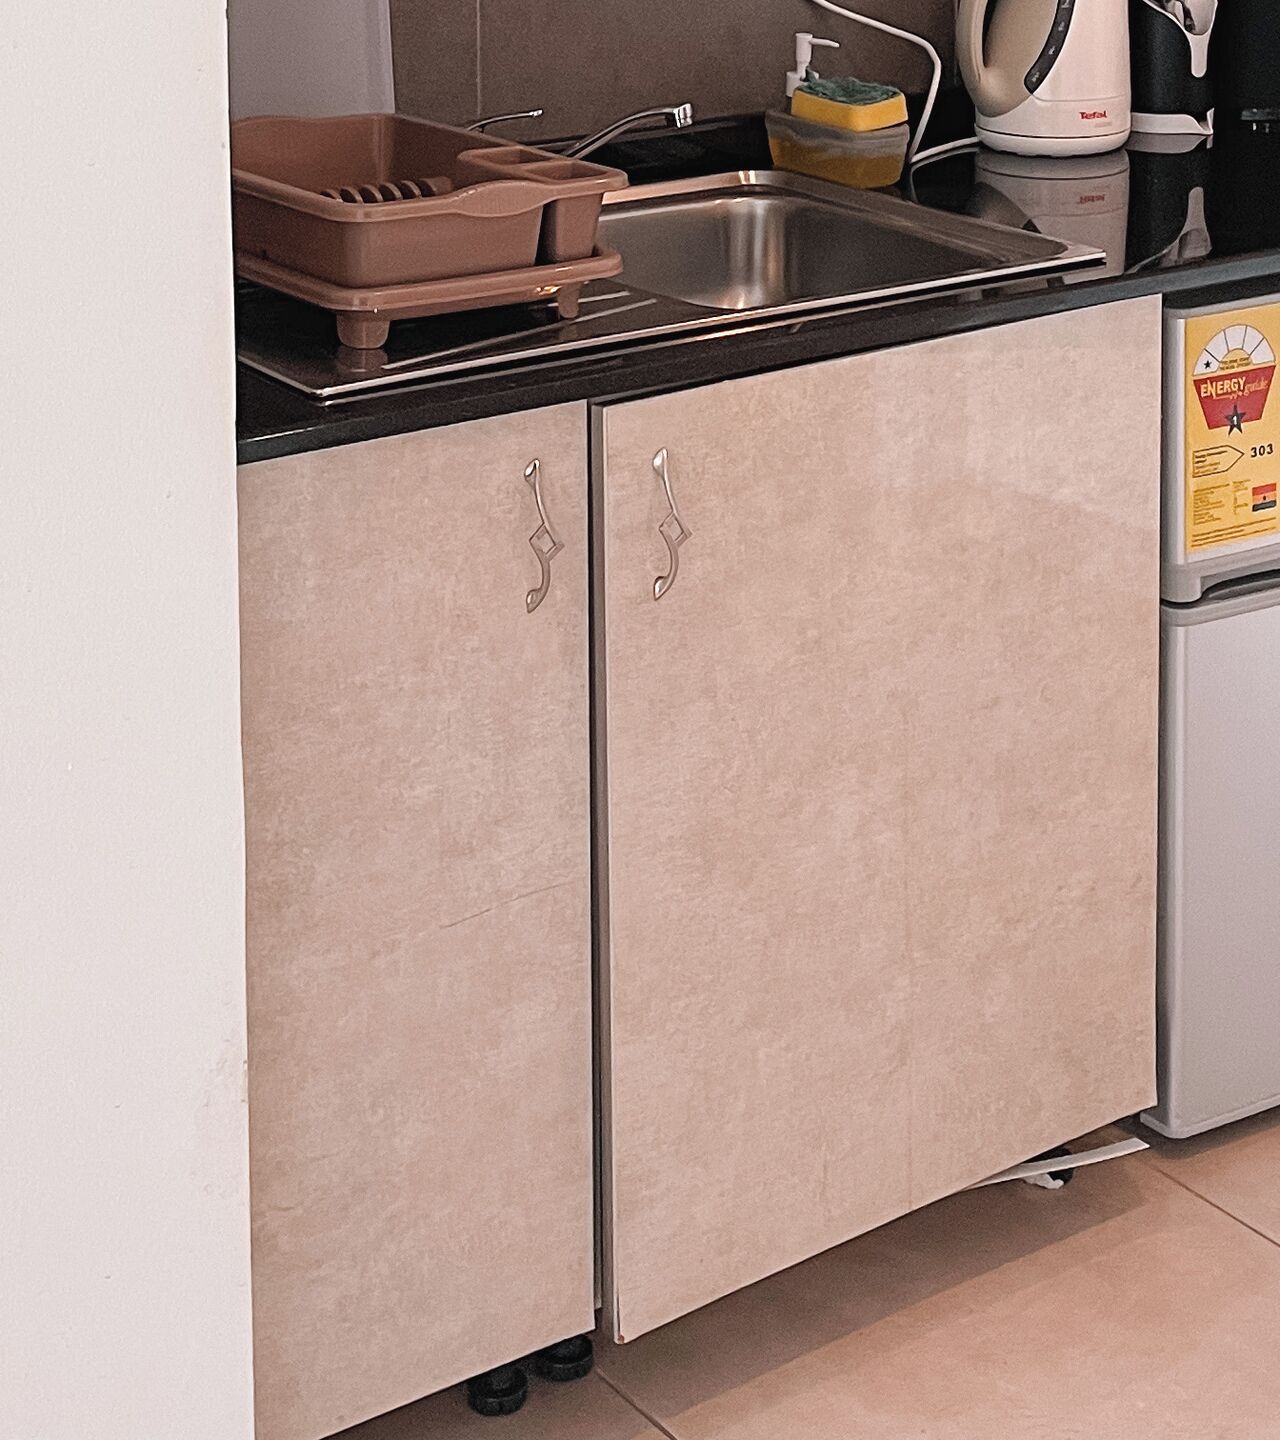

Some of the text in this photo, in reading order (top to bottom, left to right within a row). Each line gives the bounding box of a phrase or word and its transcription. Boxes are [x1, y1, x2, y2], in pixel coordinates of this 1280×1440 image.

[1079, 110, 1107, 119] Tefal
[1200, 376, 1246, 398] ENERGY
[1232, 415, 1238, 425] 1
[1250, 443, 1274, 458] 303
